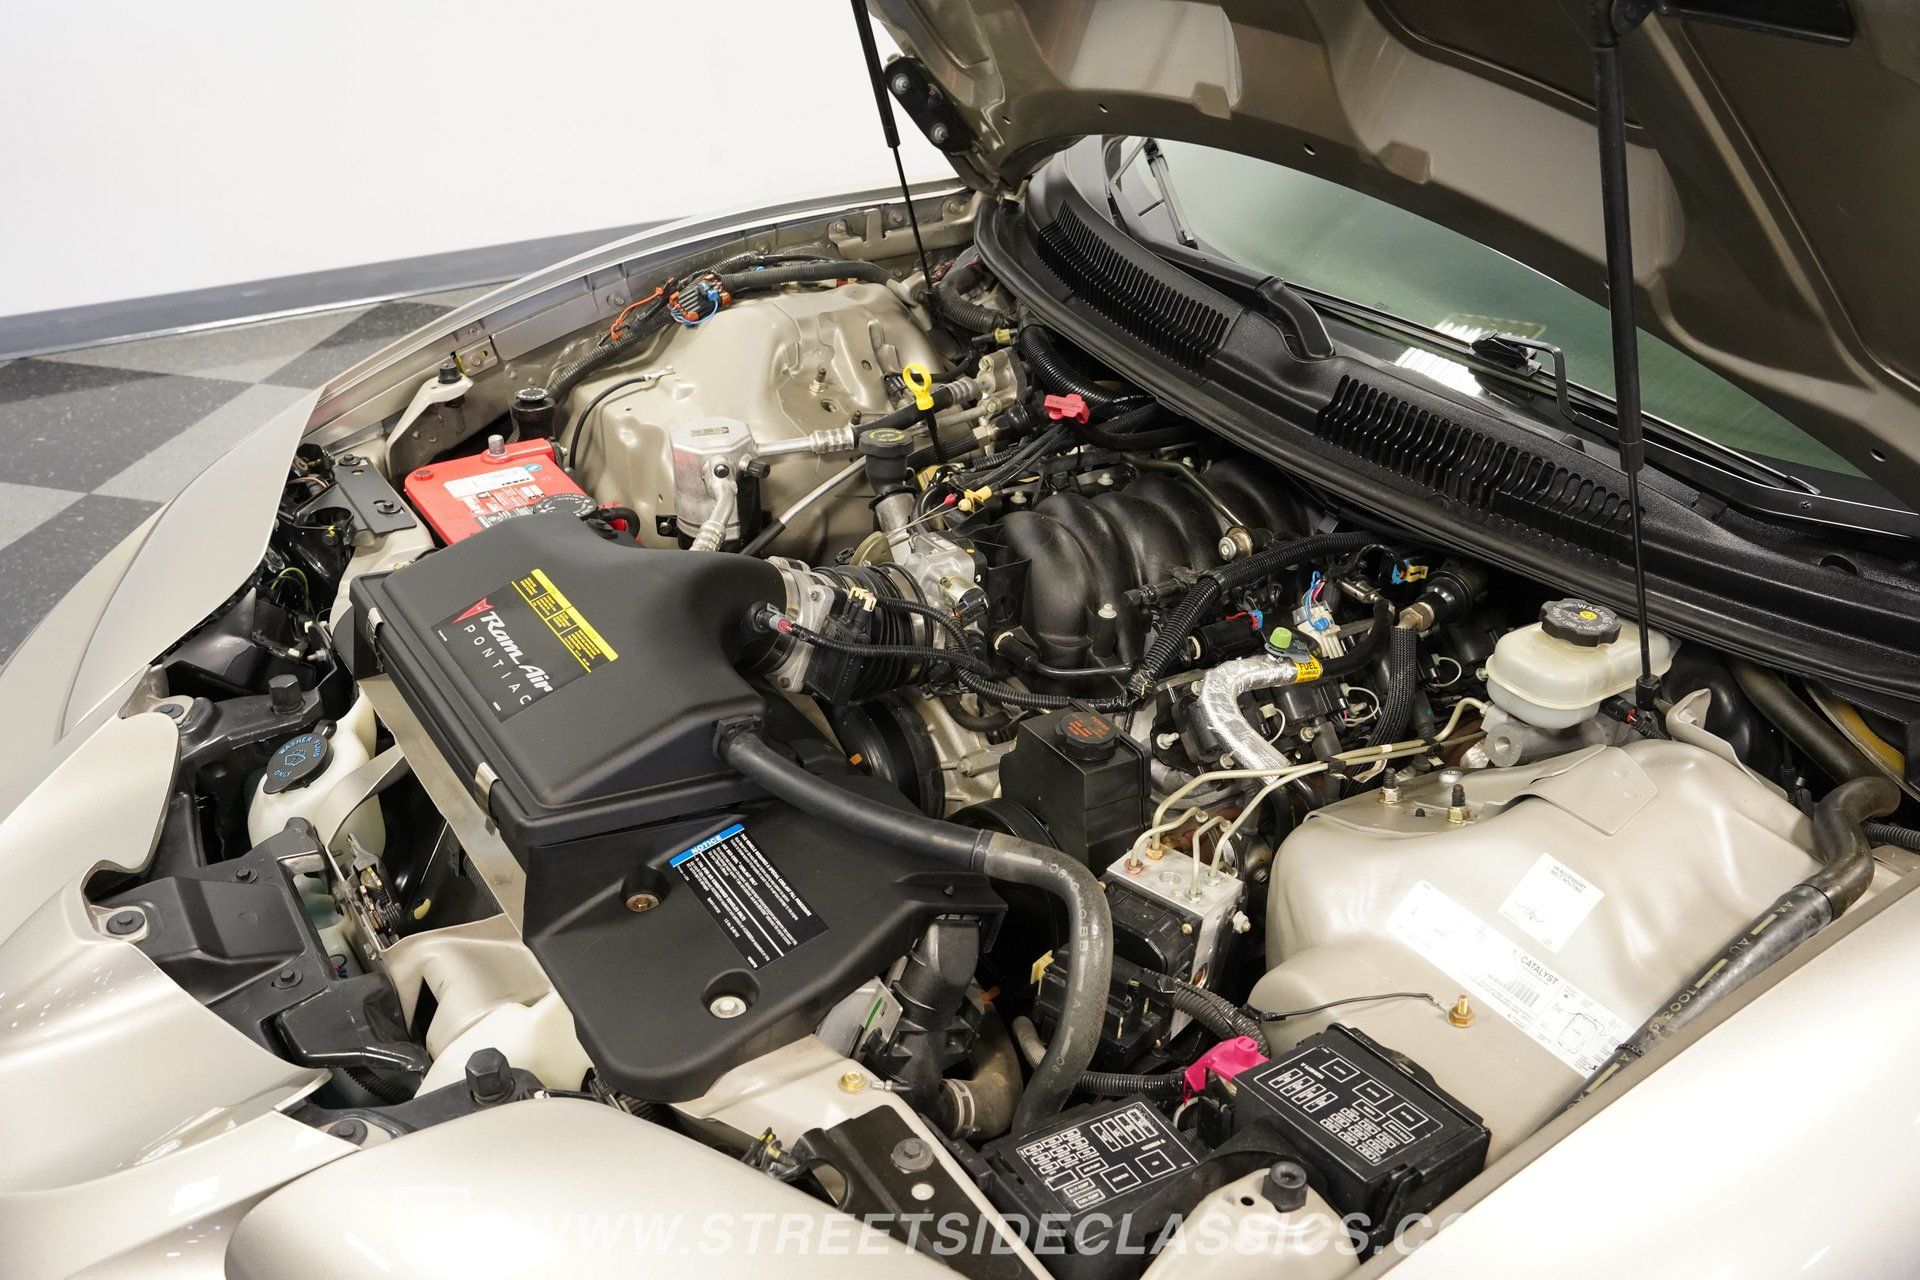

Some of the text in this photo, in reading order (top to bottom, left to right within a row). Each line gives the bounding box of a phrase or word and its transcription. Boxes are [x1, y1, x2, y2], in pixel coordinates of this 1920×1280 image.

[480, 611, 553, 693] Ram Air
[464, 624, 532, 705] PONTIAC
[1299, 662, 1319, 671] FUEL
[279, 736, 322, 758] WASHER FLUID
[274, 770, 292, 778] ONLY
[691, 834, 724, 855] NOTICE
[1521, 956, 1559, 985] CATALYST
